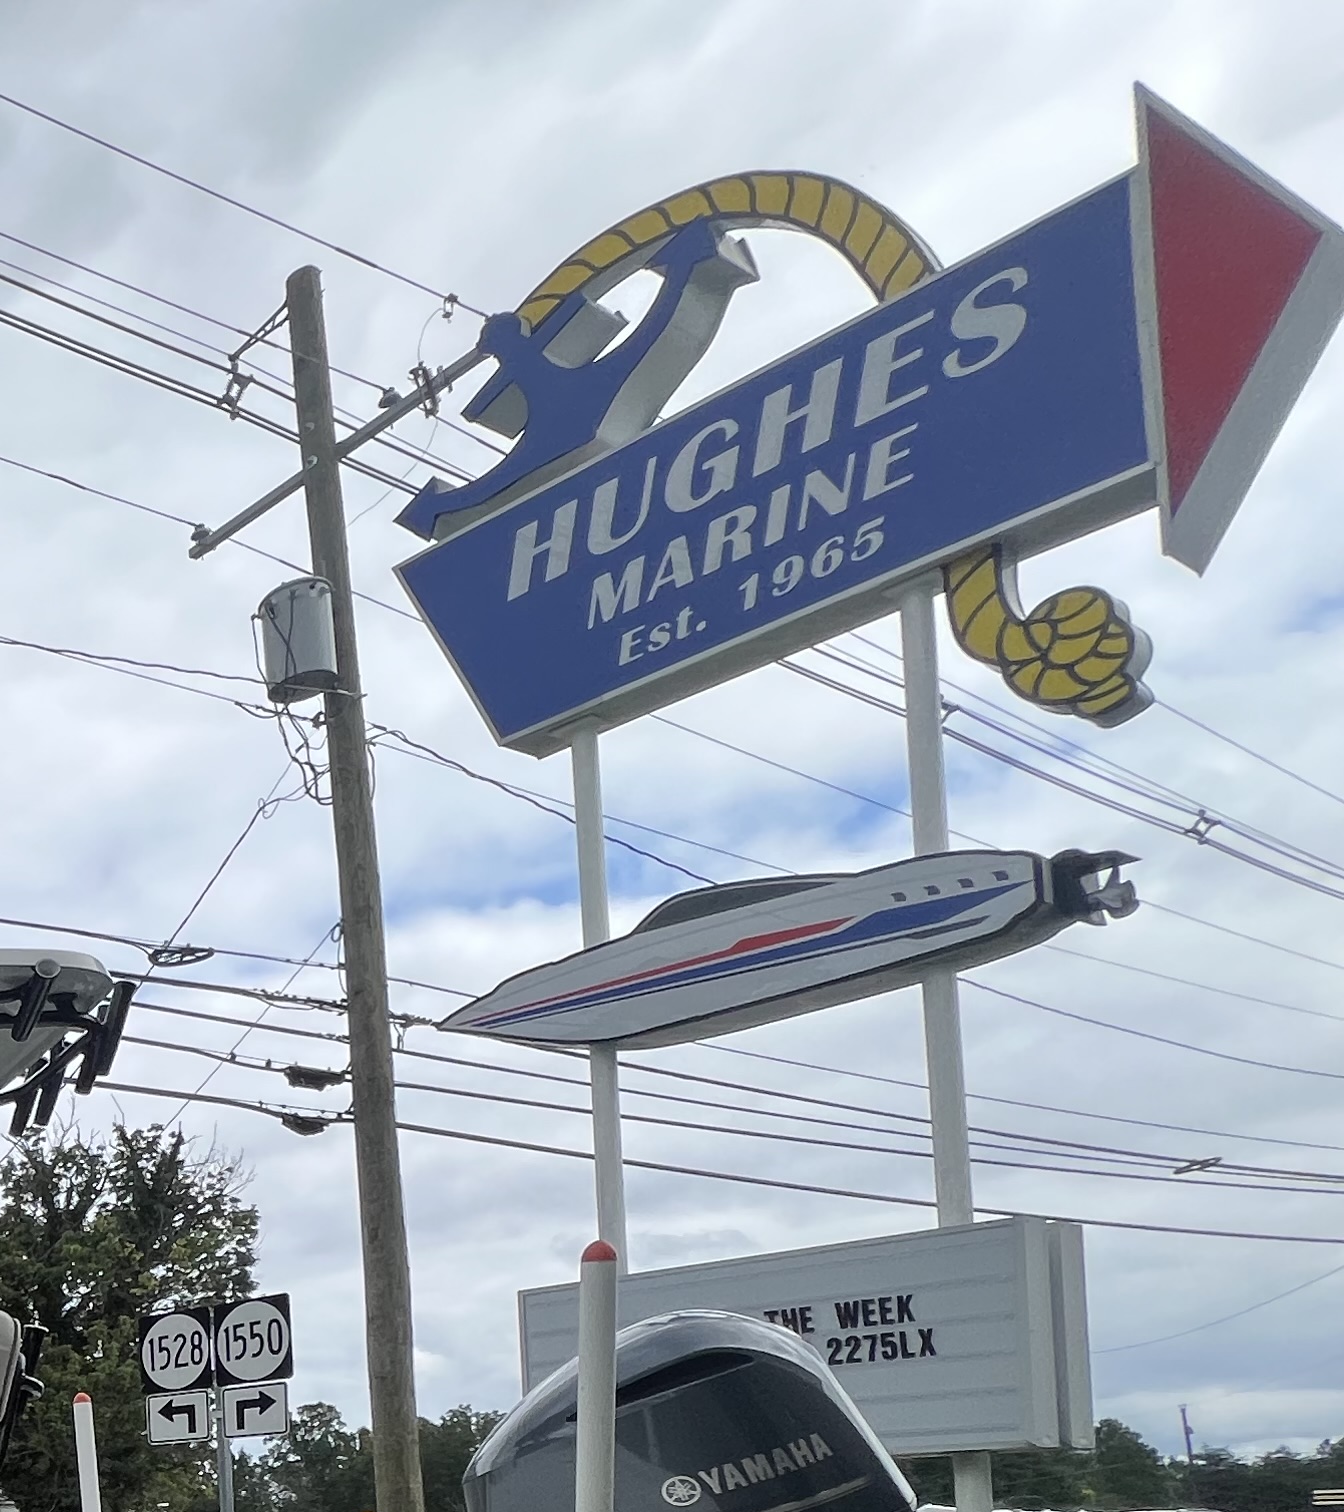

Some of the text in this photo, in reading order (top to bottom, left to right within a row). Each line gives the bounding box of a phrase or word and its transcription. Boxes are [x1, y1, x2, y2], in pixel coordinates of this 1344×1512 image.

[507, 266, 1029, 602] HUGHES
[586, 424, 918, 630] MARINE
[617, 517, 886, 667] Est. 1965
[223, 1318, 283, 1362] 1550
[764, 1294, 916, 1335] THE WEEK
[148, 1330, 204, 1372] 1528
[826, 1328, 937, 1365] 2275LX
[697, 1433, 833, 1494] YAMAHA
